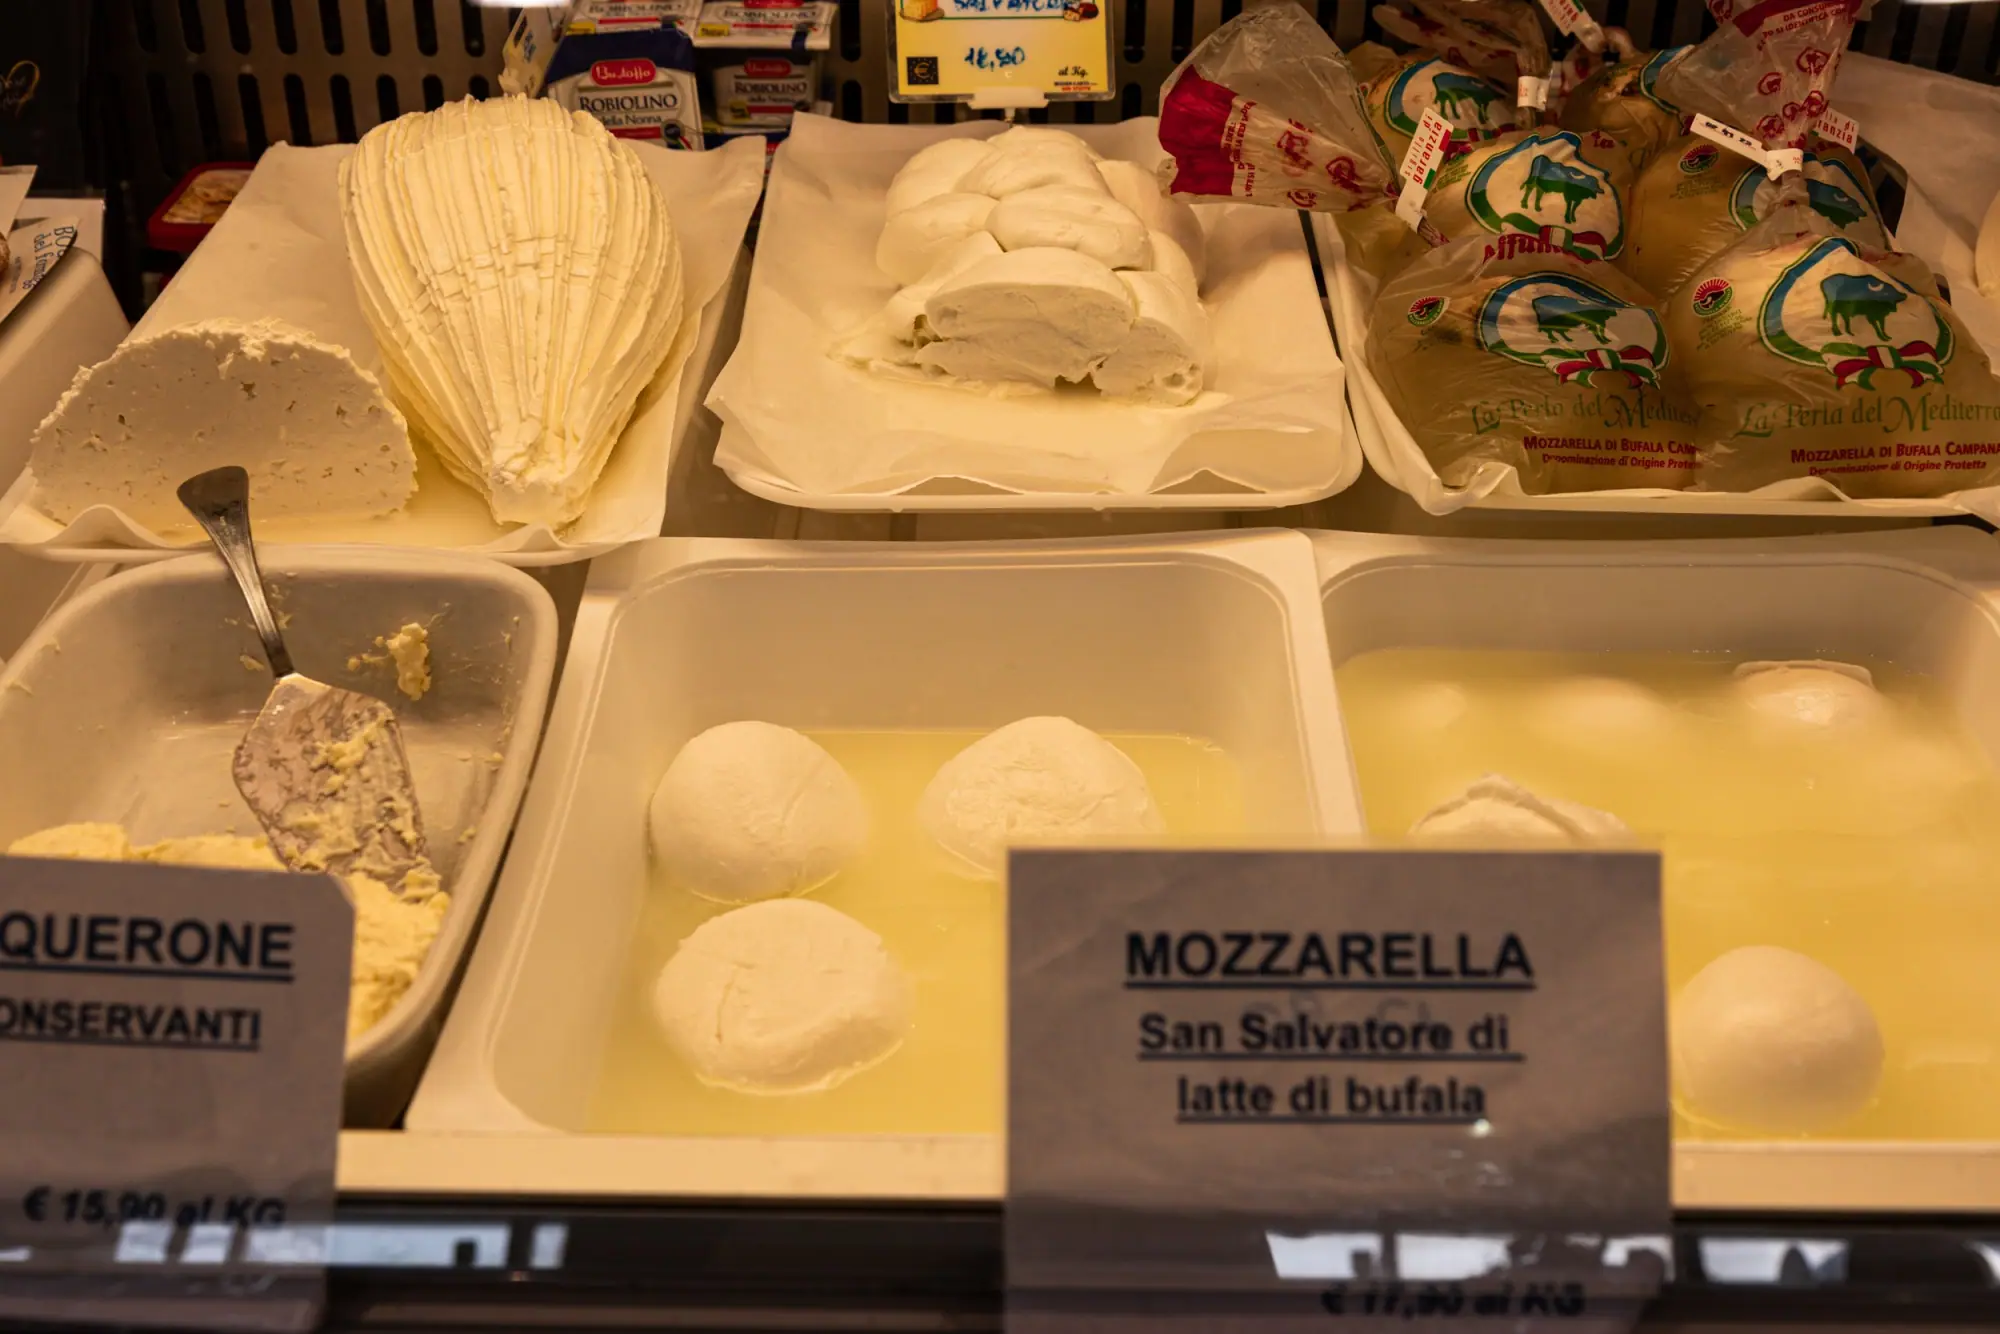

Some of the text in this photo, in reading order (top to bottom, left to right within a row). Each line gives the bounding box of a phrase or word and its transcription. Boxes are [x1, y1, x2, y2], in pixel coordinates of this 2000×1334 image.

[579, 93, 678, 113] ROBIOLINO
[1412, 120, 1443, 185] garanzia
[1780, 400, 1844, 428] Perla
[1850, 396, 1883, 425] del
[1522, 436, 1602, 452] MOZZARELLA
[1620, 438, 1665, 454] BUFALA
[1791, 446, 1876, 464] MOZZARELLA
[1895, 442, 1942, 458] BUFALA
[1630, 456, 1666, 471] Origine
[1903, 459, 1942, 473] Origine
[1943, 459, 1988, 470] Protetta
[1125, 932, 1535, 979] MOZZARELLA
[1138, 1012, 1510, 1052] San Salvatore di
[1178, 1076, 1486, 1114] latte di bufala
